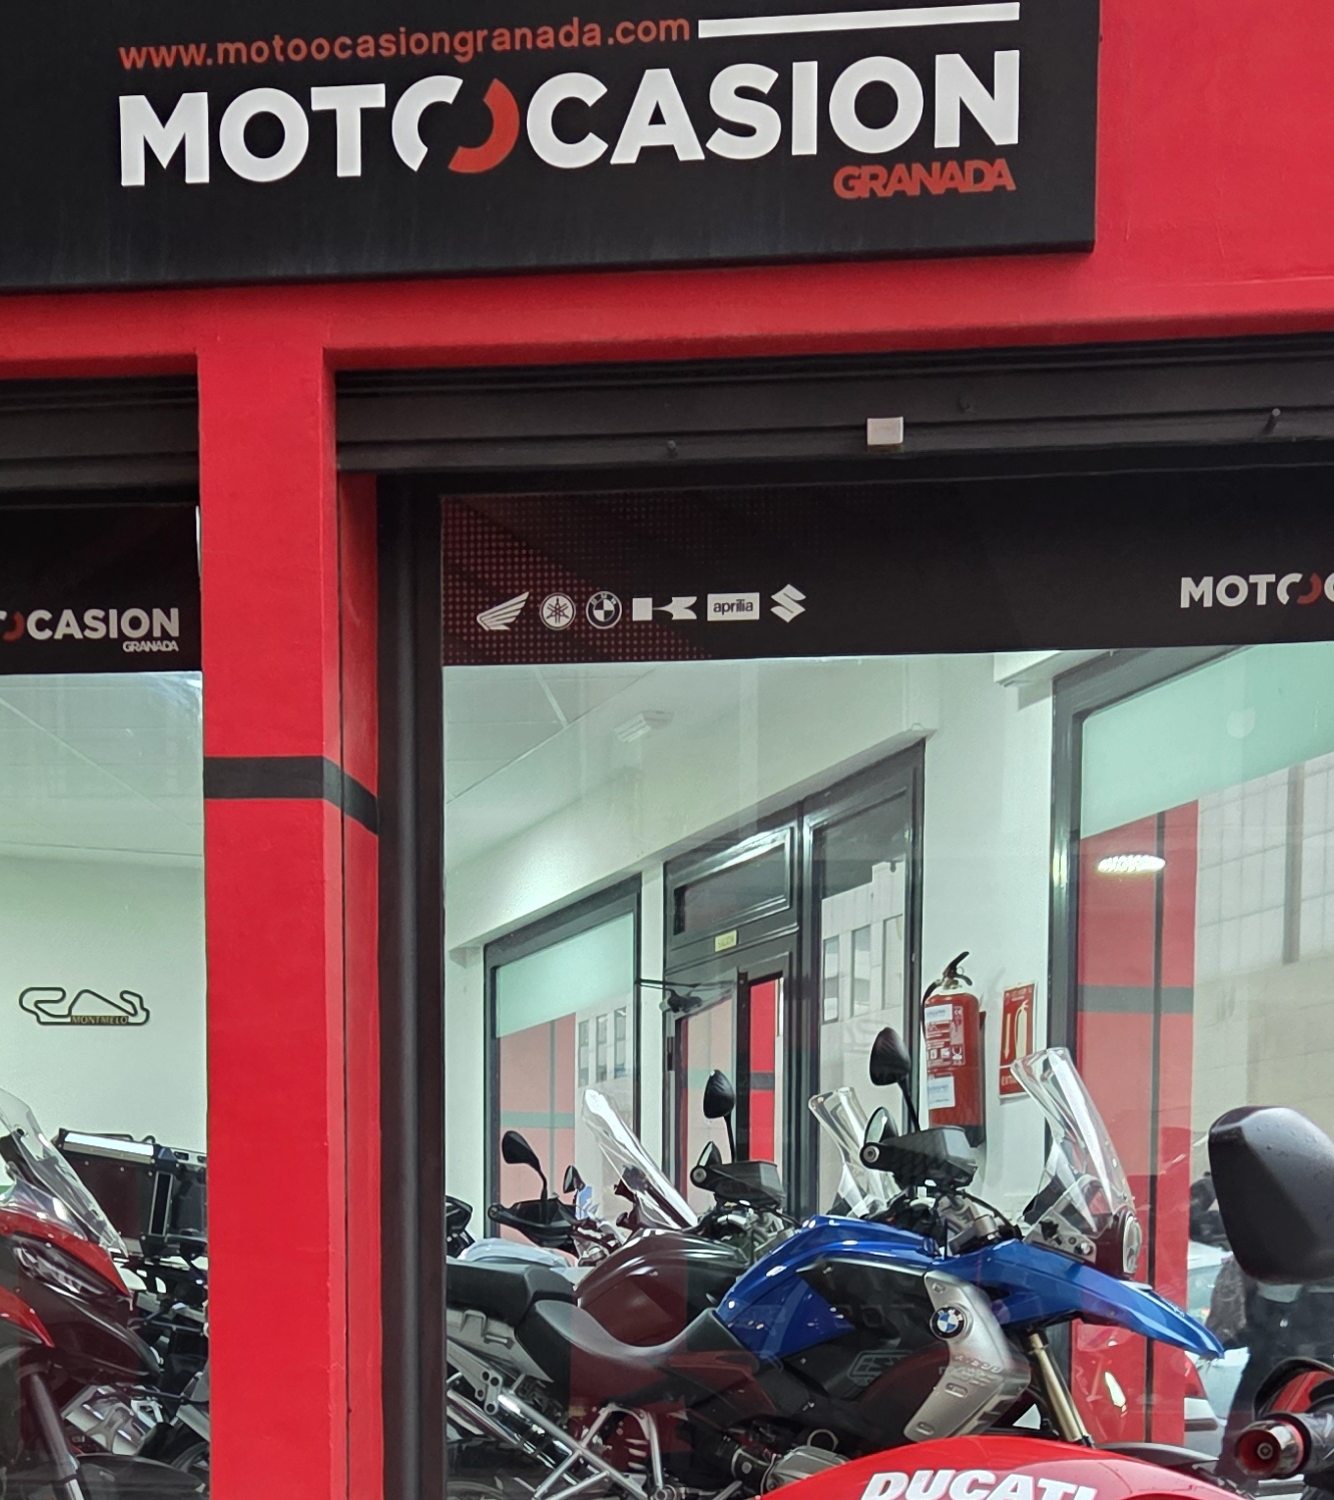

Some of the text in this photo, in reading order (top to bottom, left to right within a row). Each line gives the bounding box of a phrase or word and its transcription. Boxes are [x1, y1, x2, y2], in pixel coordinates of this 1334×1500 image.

[118, 16, 691, 71] www.motoocasiongranada.com
[833, 158, 1017, 200] GRANADA
[712, 599, 754, 614] aprilia
[122, 640, 180, 653] GRANADA
